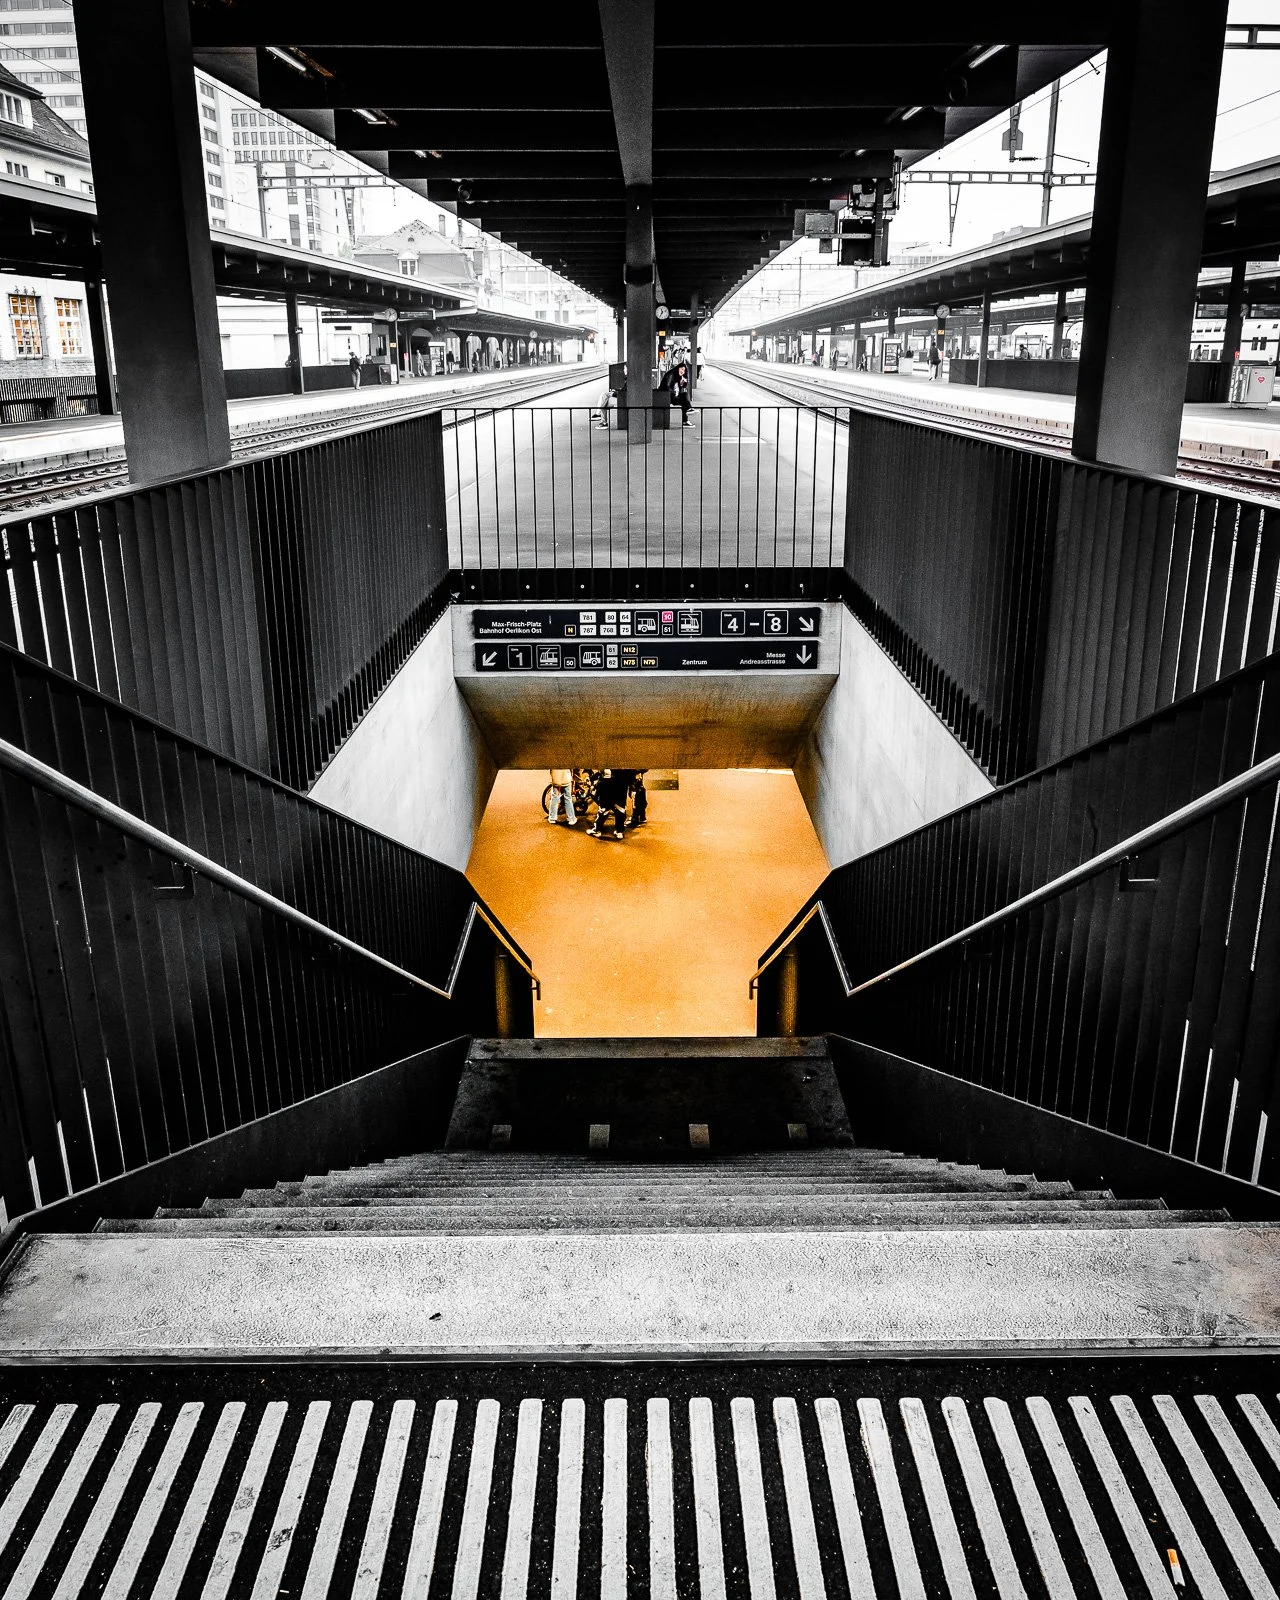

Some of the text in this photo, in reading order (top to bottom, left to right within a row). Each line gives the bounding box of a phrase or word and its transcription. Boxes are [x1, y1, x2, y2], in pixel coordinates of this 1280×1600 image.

[727, 617, 739, 632] 4
[770, 617, 782, 632] 8
[516, 652, 523, 666] 1
